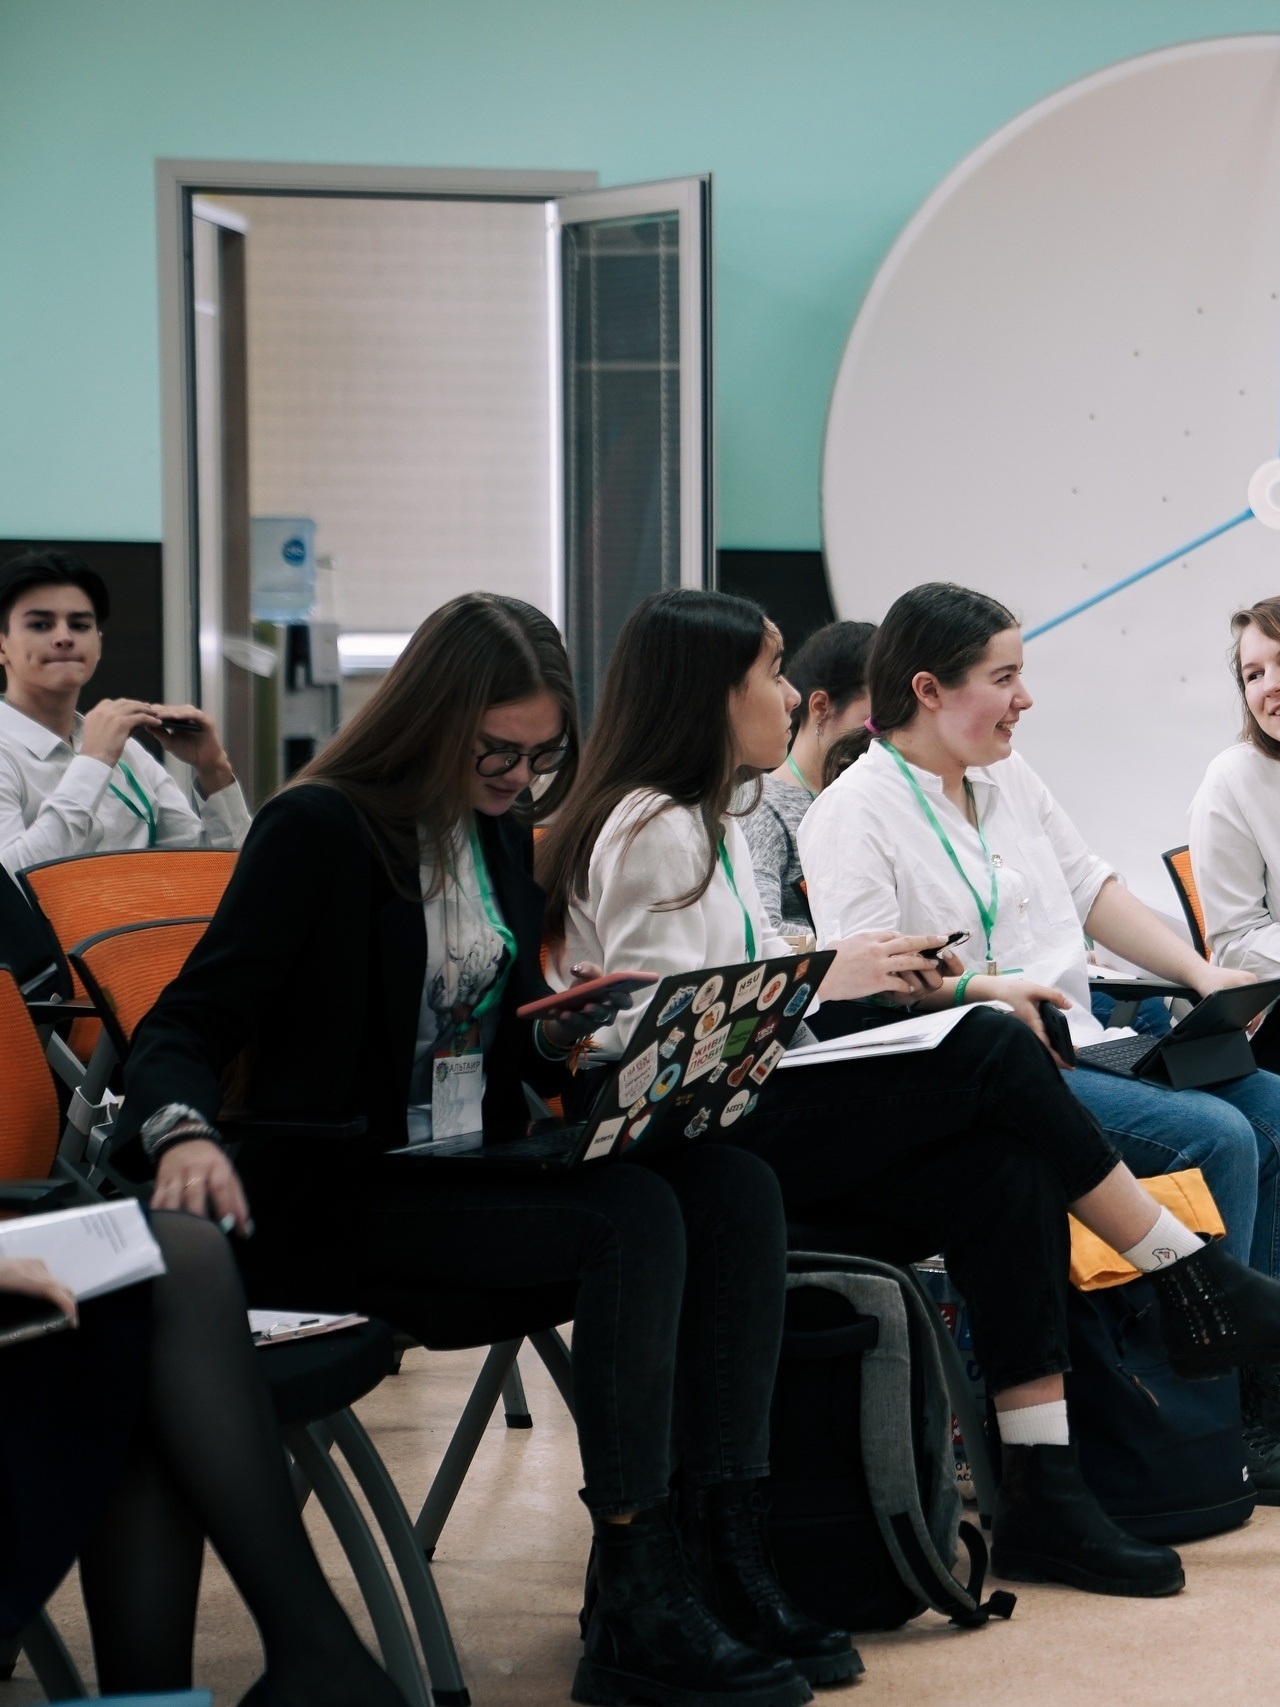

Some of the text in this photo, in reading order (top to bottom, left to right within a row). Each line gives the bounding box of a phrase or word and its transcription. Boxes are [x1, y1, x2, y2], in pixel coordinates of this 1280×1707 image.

[739, 972, 760, 991] NSU
[694, 1033, 727, 1058] ЖИВИ
[449, 1061, 481, 1072] АЛЬТАИР
[688, 1045, 724, 1073] ЛЮБИ
